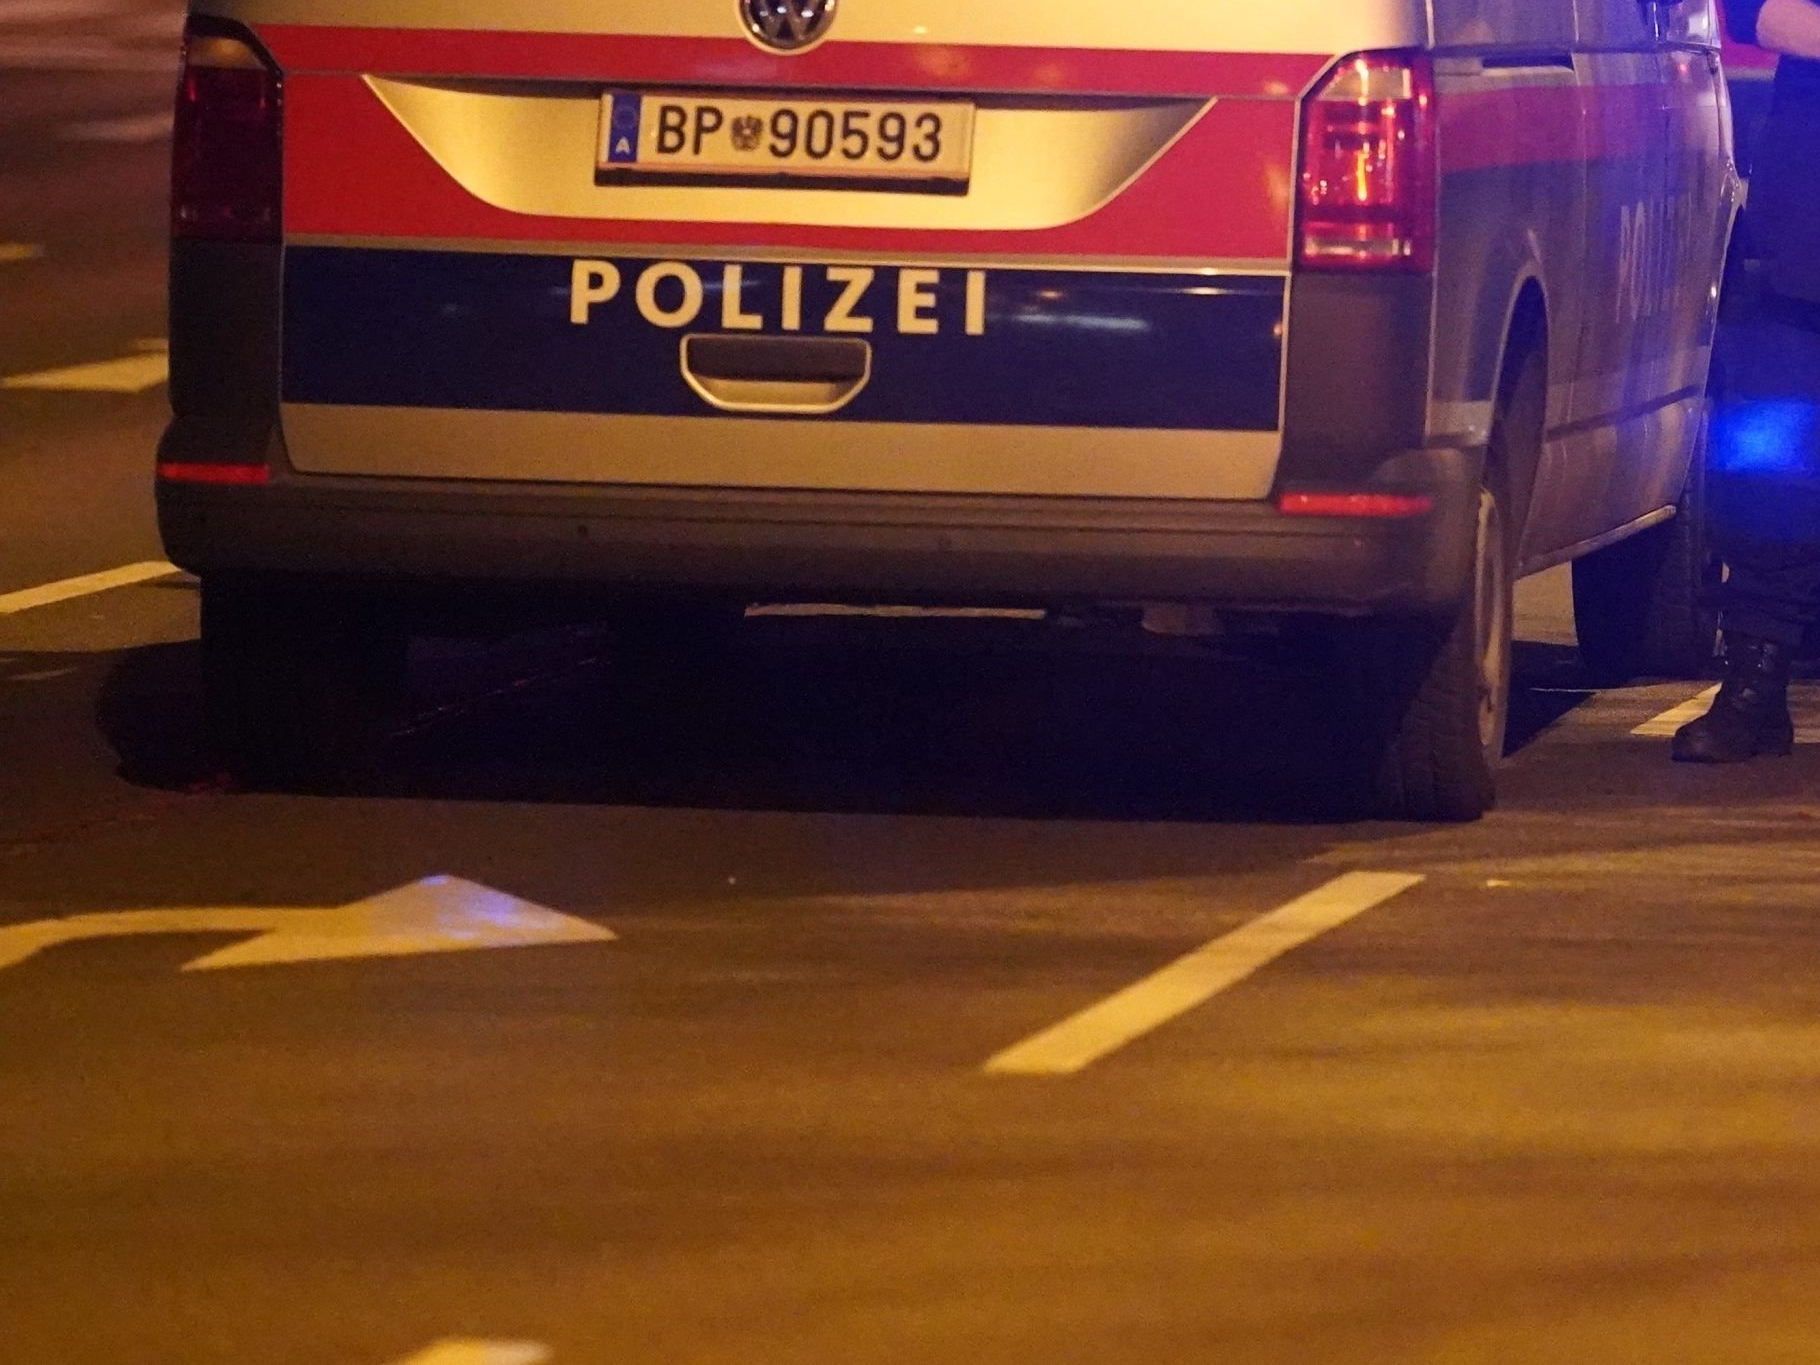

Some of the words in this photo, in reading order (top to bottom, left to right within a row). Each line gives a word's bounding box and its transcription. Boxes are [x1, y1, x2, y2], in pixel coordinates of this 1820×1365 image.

[614, 137, 631, 155] A
[655, 104, 723, 155] BP
[768, 108, 943, 163] 90593
[570, 259, 986, 336] POLIZEI
